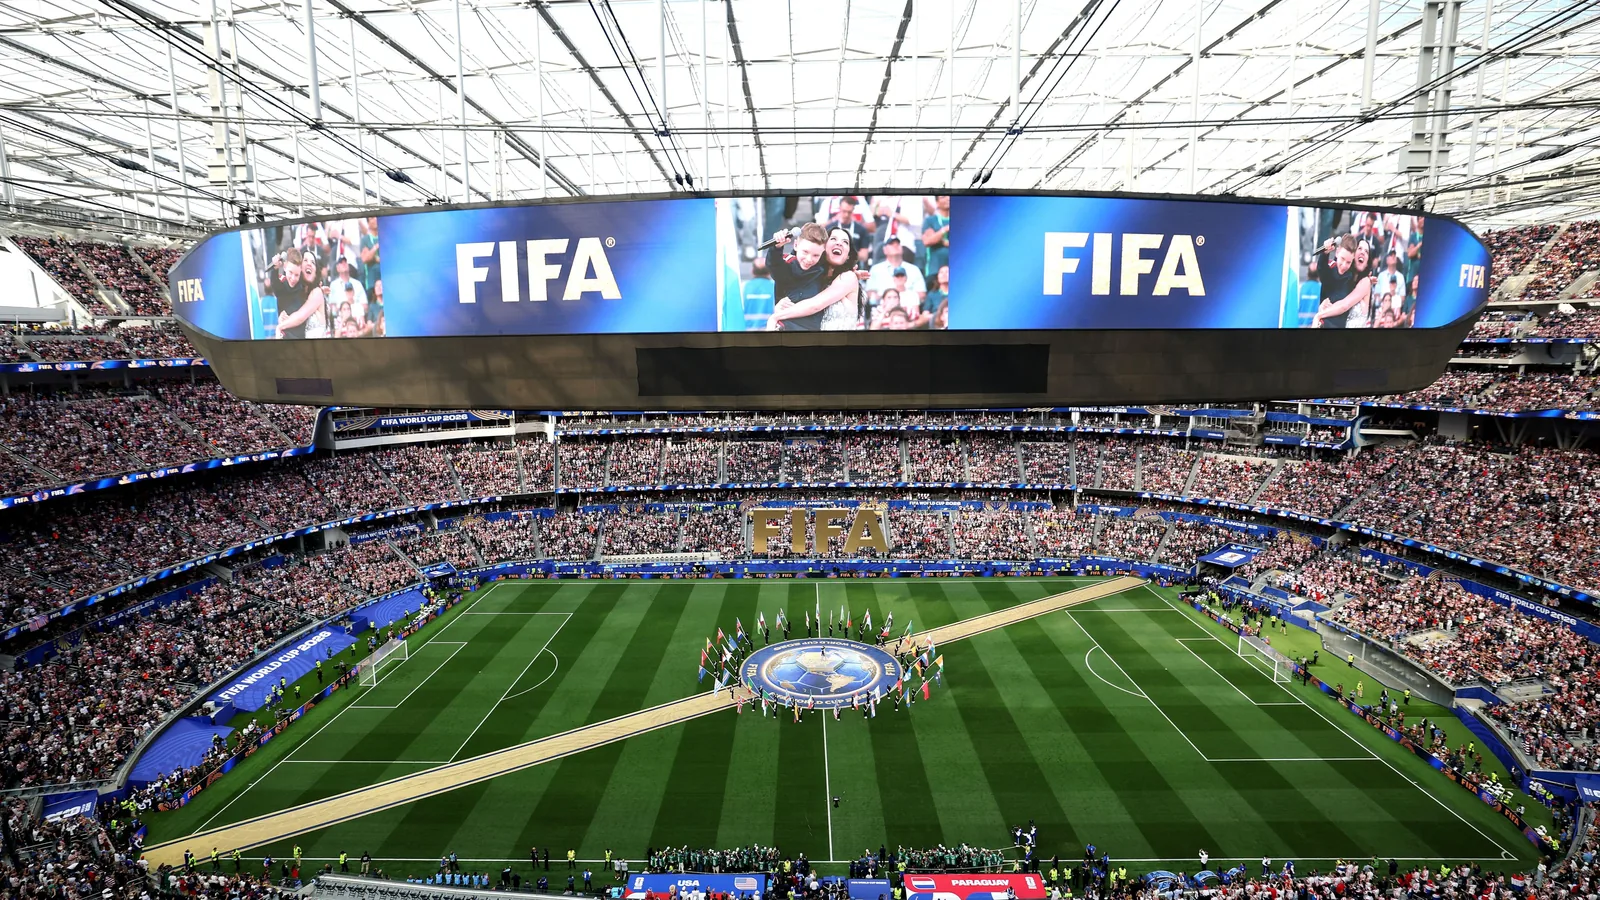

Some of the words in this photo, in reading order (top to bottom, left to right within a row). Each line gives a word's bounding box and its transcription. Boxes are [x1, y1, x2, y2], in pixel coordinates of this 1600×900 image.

[1459, 264, 1485, 288] FIFA
[177, 278, 204, 302] FIFA
[399, 416, 427, 424] WORLD
[427, 415, 442, 423] CUP
[753, 508, 889, 553] FIFA
[1224, 520, 1258, 529] ANGEES
[1495, 591, 1510, 601] FIFA
[1511, 597, 1535, 610] WORLD
[1535, 605, 1550, 615] CUP
[218, 684, 248, 699] FIFA
[241, 662, 282, 684] WORLD
[278, 649, 299, 662] CUP
[297, 631, 331, 651] 2026
[747, 663, 758, 677] FIFA
[884, 662, 896, 676] FIFA
[1352, 705, 1364, 716] FIFA
[1382, 725, 1396, 738] FIFA
[187, 784, 202, 799] FIFA
[260, 731, 273, 744] FIFA
[1461, 778, 1478, 794] FIFA
[1504, 808, 1519, 825] FIFA
